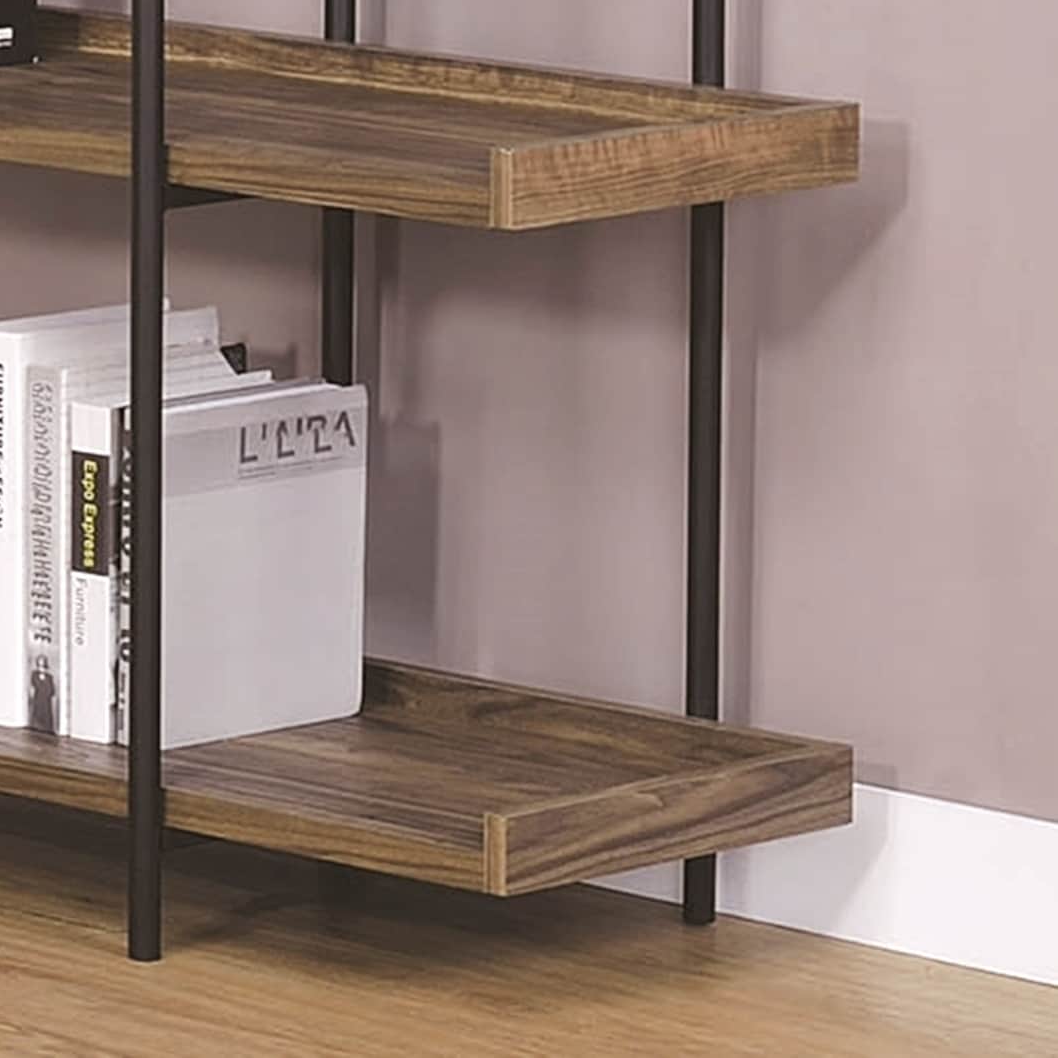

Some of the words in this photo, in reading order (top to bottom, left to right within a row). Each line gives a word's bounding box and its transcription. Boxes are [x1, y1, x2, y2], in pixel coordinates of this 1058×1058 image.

[82, 459, 98, 500] Expo
[81, 502, 98, 568] Express
[75, 577, 87, 646] Furniture
